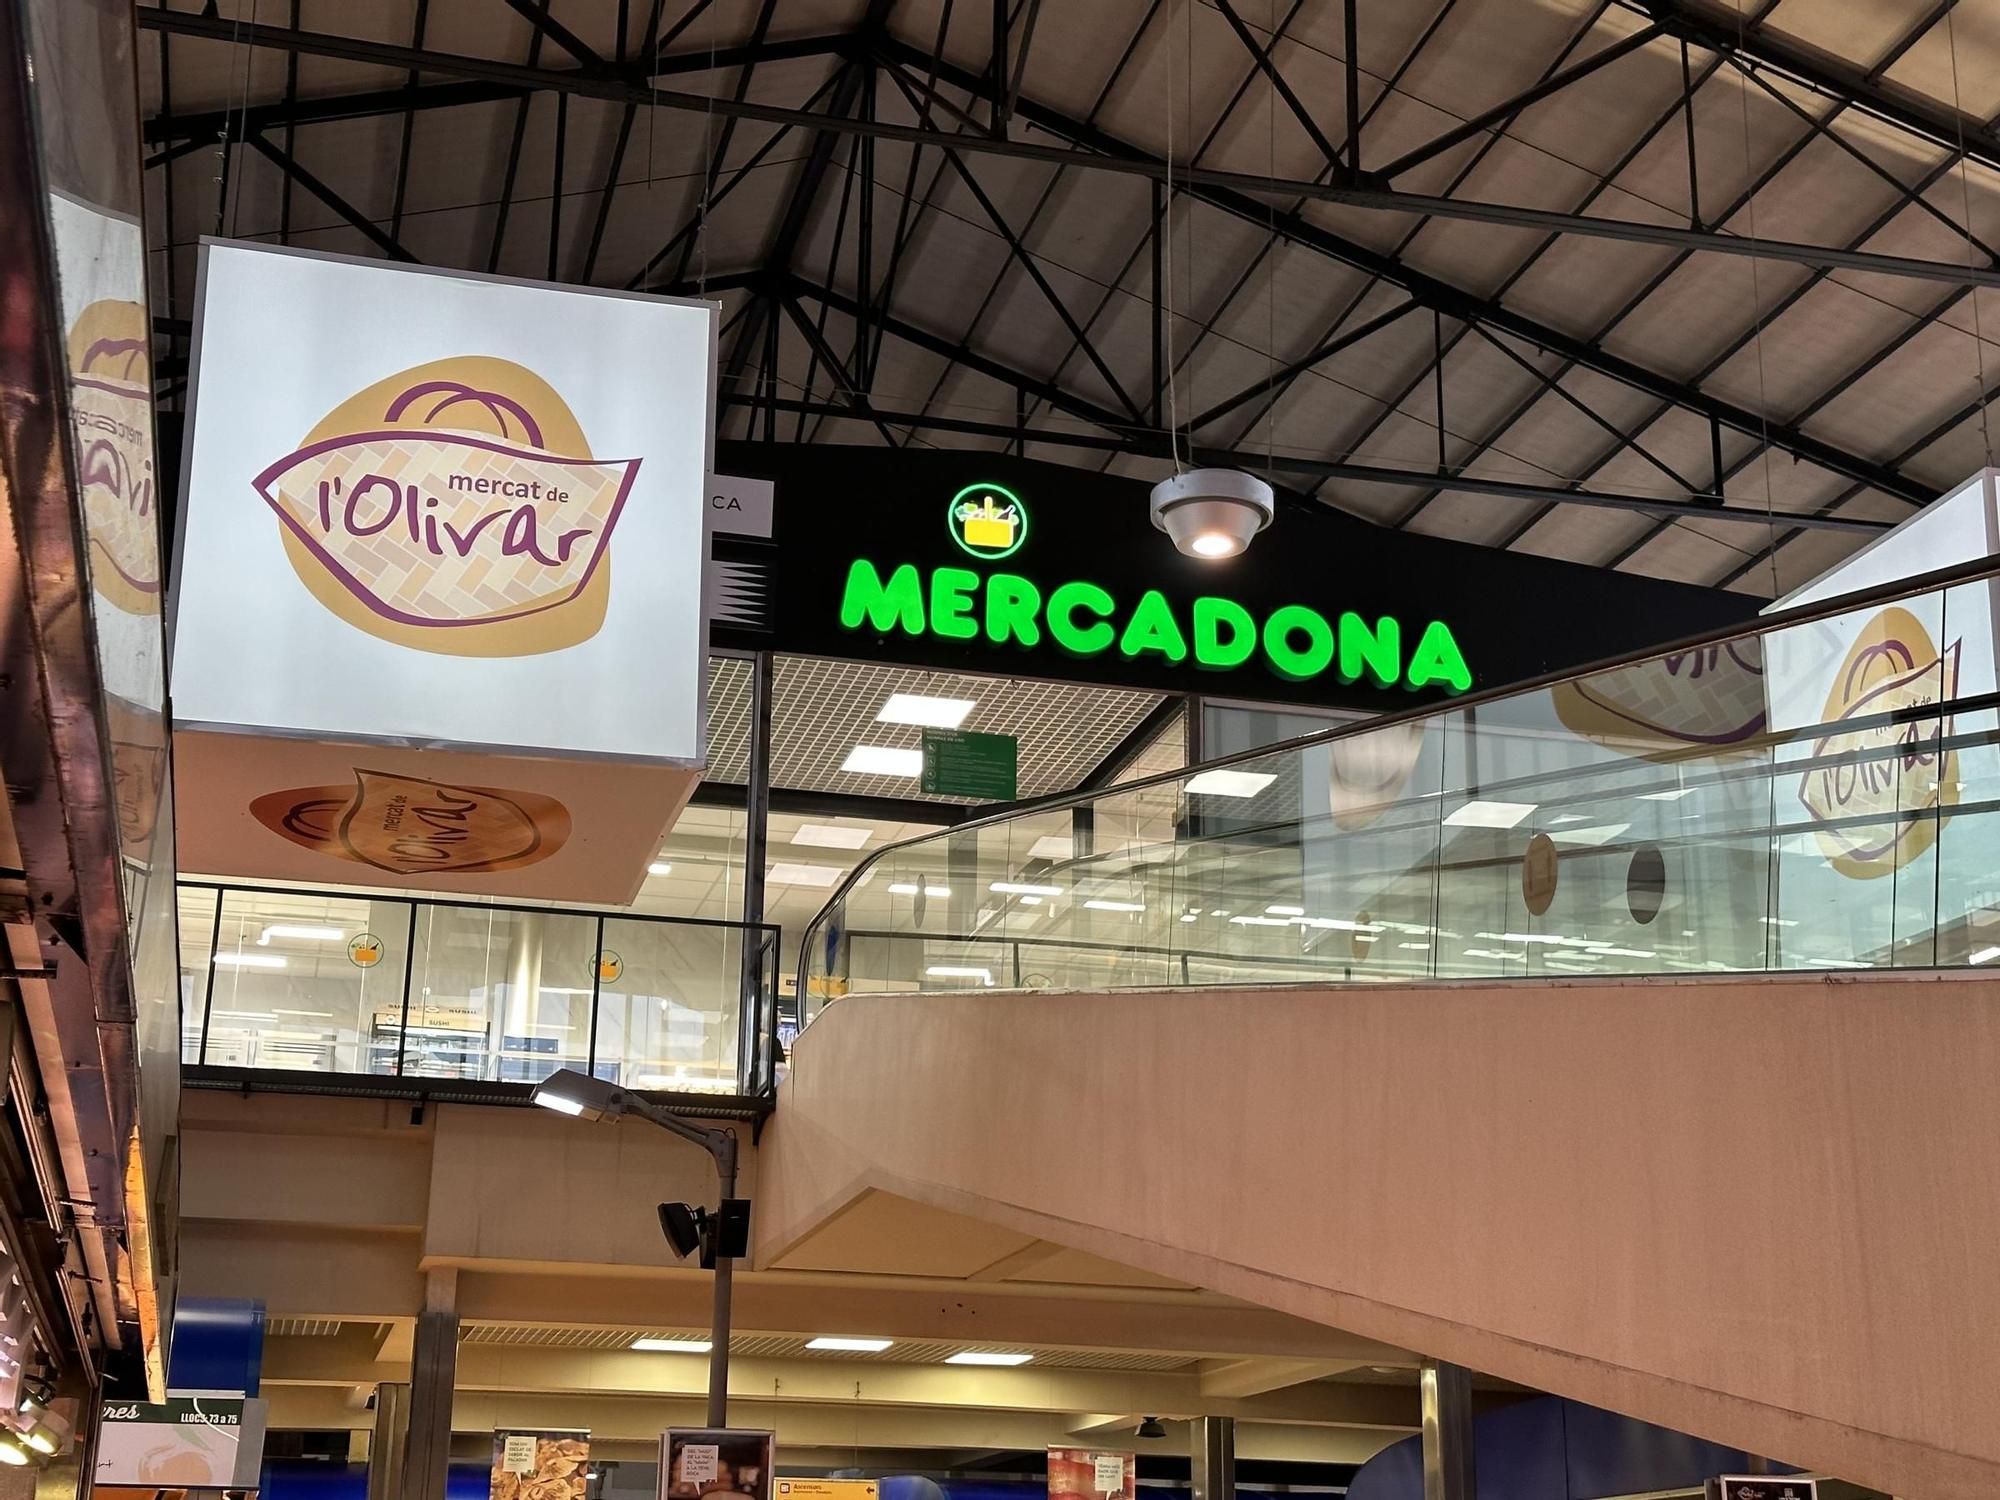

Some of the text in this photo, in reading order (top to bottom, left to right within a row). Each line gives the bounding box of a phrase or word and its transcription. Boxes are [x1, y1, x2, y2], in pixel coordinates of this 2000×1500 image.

[448, 471, 569, 503] mercat de
[318, 473, 593, 567] l'Olivar
[839, 558, 1473, 692] MERCADONA
[383, 794, 409, 832] mercat de
[429, 1019, 450, 1027] SUSHI
[103, 1404, 140, 1419] res
[209, 1413, 219, 1423] 73
[220, 1415, 227, 1424] a
[227, 1414, 238, 1424] 75
